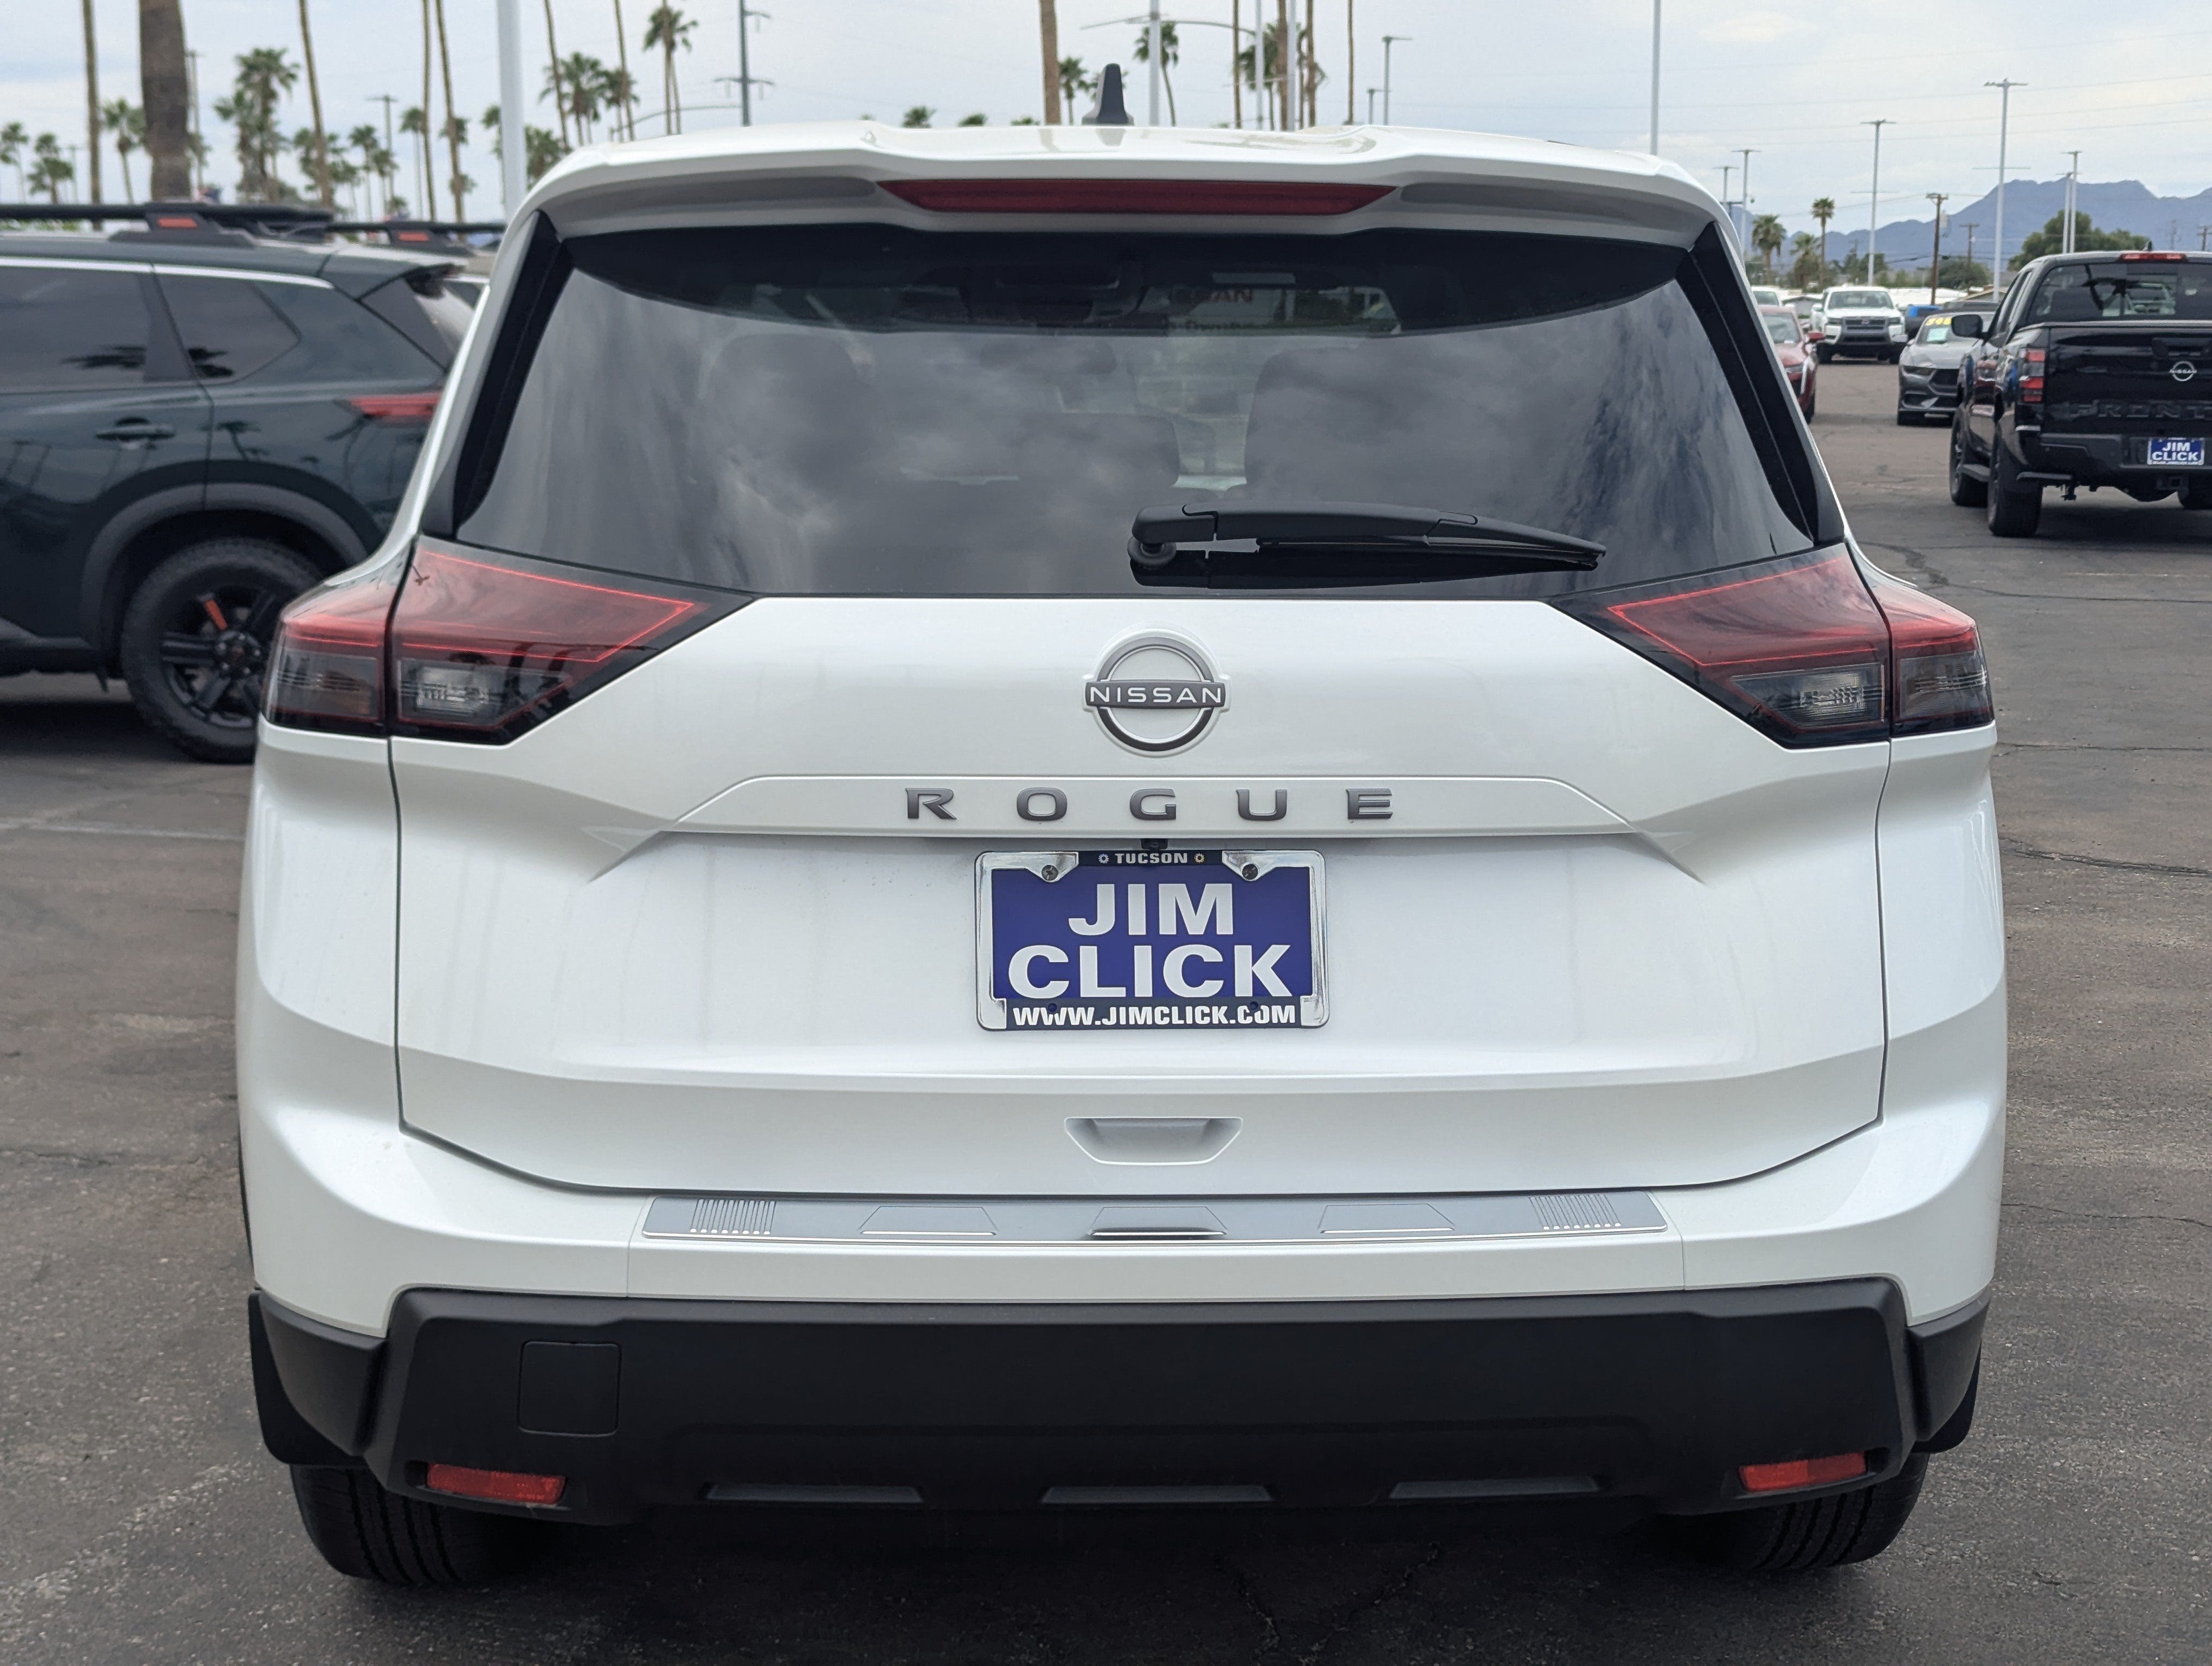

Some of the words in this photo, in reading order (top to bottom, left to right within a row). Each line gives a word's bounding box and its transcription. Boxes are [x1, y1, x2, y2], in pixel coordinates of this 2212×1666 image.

[2152, 451, 2198, 461] CLICK
[2162, 442, 2190, 451] JIM
[1090, 686, 1221, 703] NISSAN
[905, 787, 1393, 822] ROGUE
[1114, 853, 1188, 864] TUCSON
[1068, 883, 1233, 935] JIM
[1008, 944, 1293, 998] CLICK
[1012, 1005, 1296, 1026] WWW.JIMCLICK.COM
